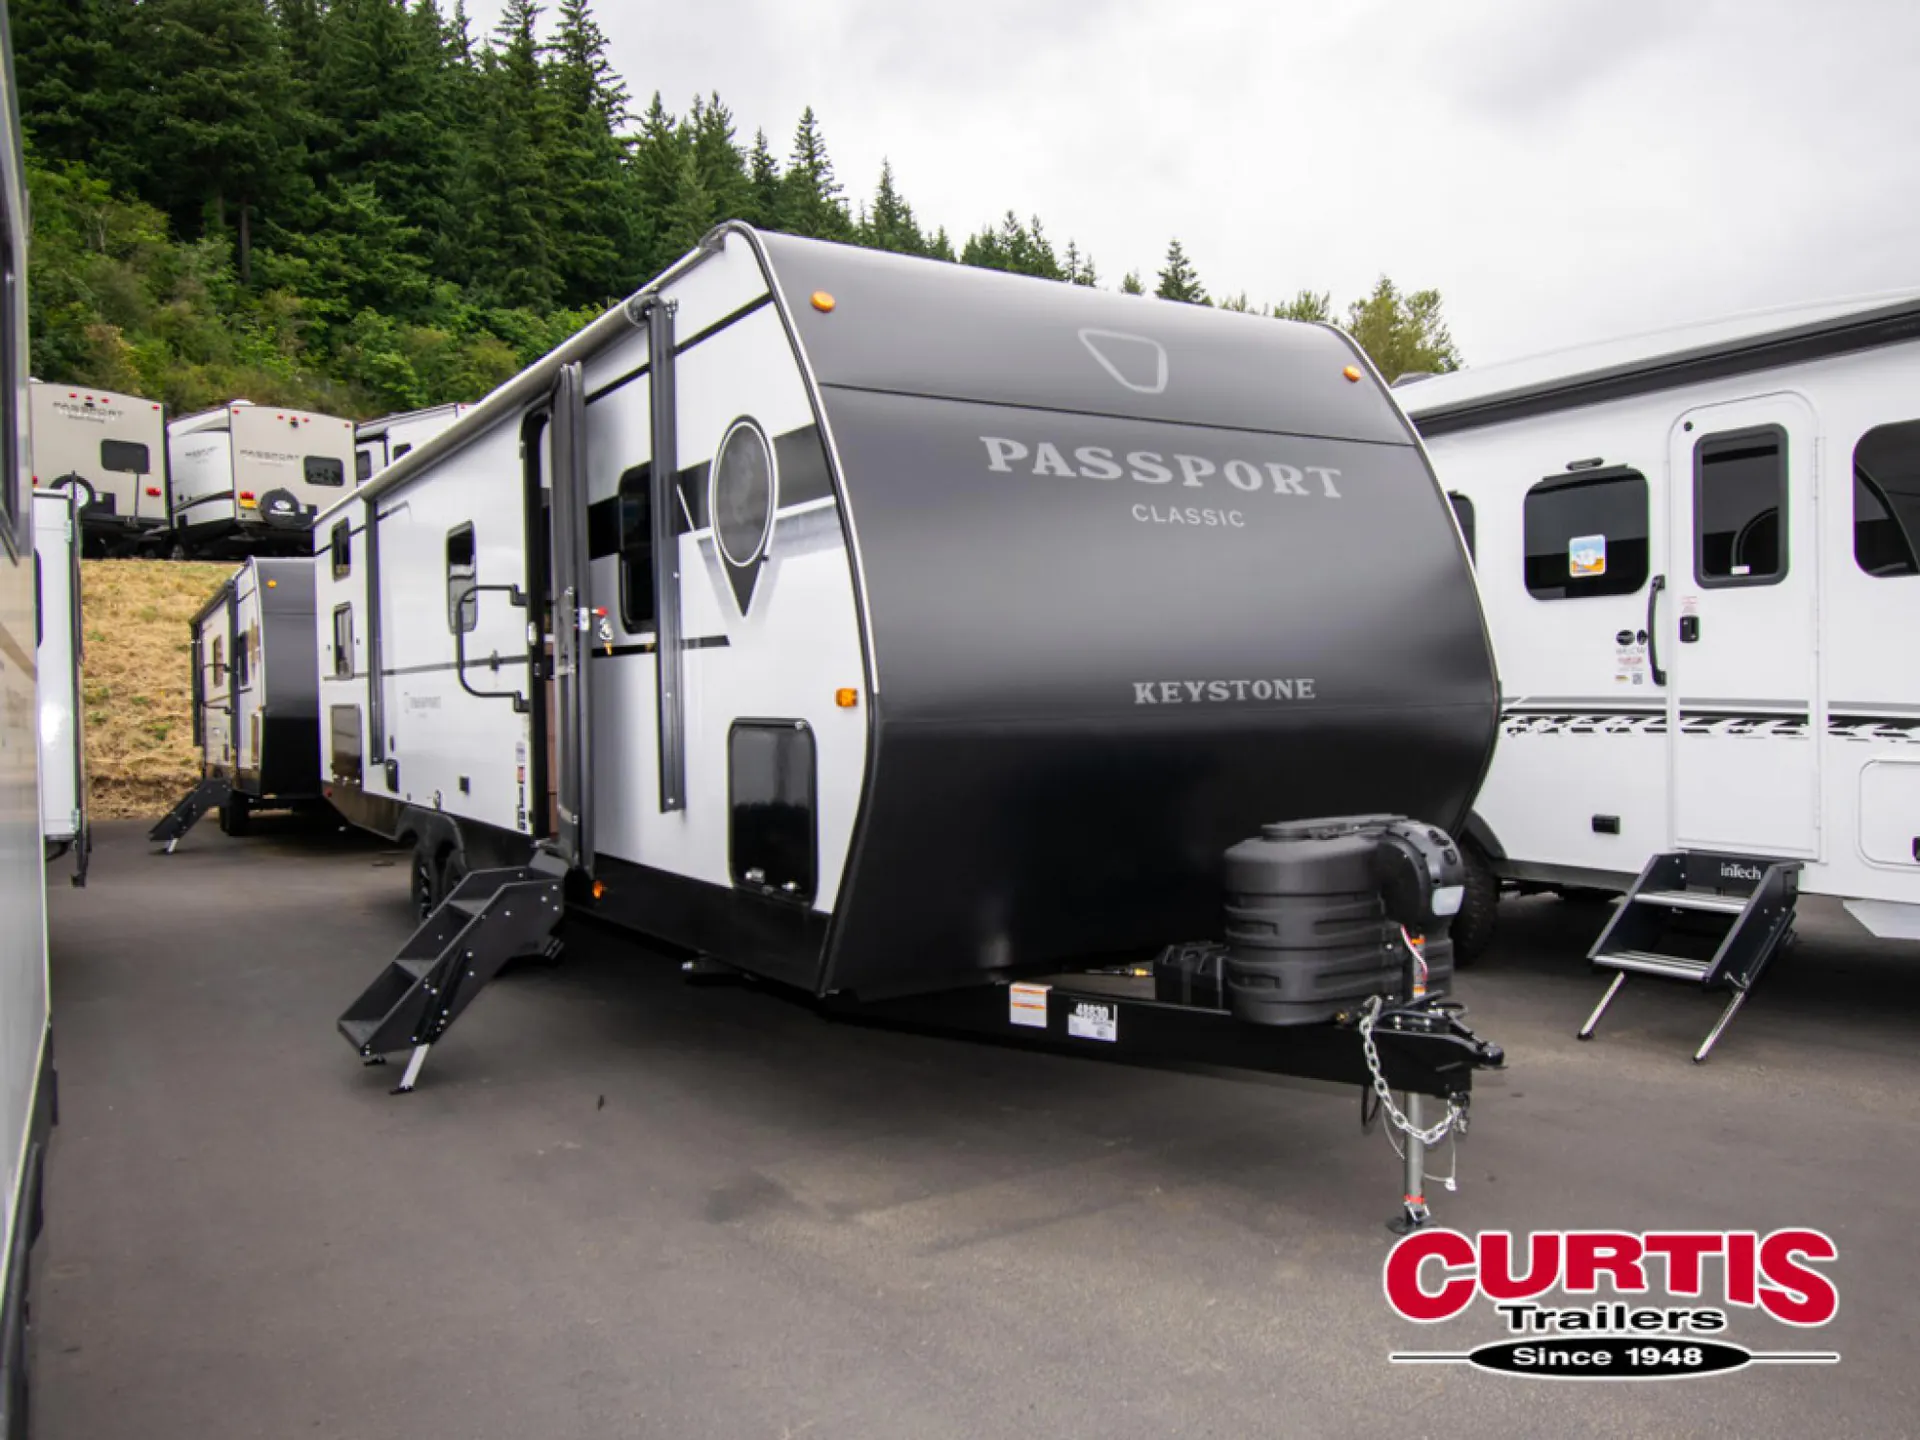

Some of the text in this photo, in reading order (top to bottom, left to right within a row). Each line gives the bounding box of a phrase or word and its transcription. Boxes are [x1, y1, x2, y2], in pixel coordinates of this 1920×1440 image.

[979, 435, 1343, 498] PASSPORT
[1131, 503, 1246, 528] CLASSIC
[1132, 678, 1317, 705] KEYSTONE
[1720, 861, 1762, 880] inTech
